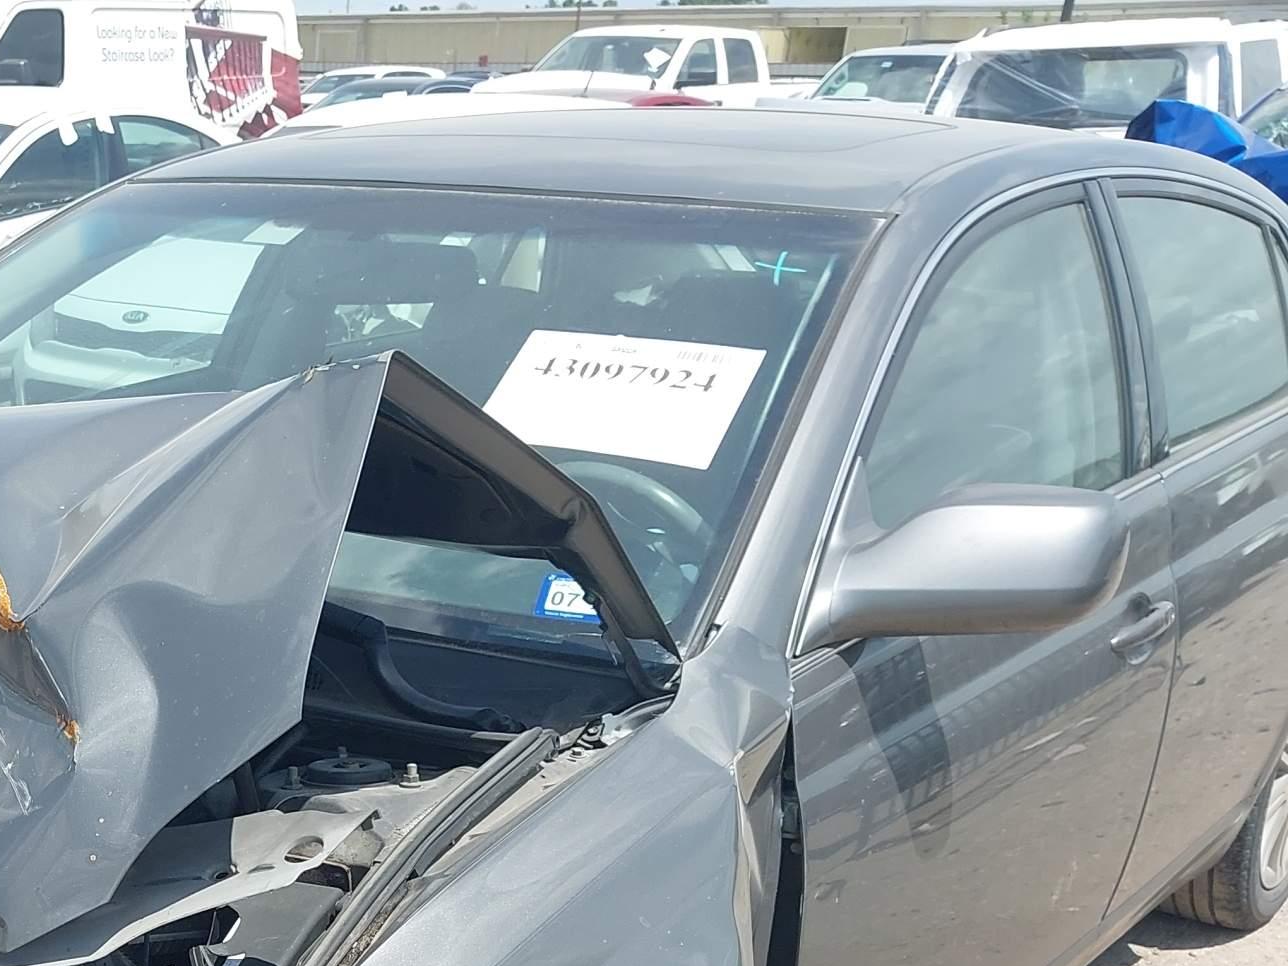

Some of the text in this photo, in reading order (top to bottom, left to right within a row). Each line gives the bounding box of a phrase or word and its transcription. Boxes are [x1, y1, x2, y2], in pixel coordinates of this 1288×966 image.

[96, 25, 132, 43] Looking
[135, 25, 147, 39] for
[101, 47, 145, 62] Staircase
[534, 356, 717, 392] 43097924
[551, 591, 581, 607] 07
